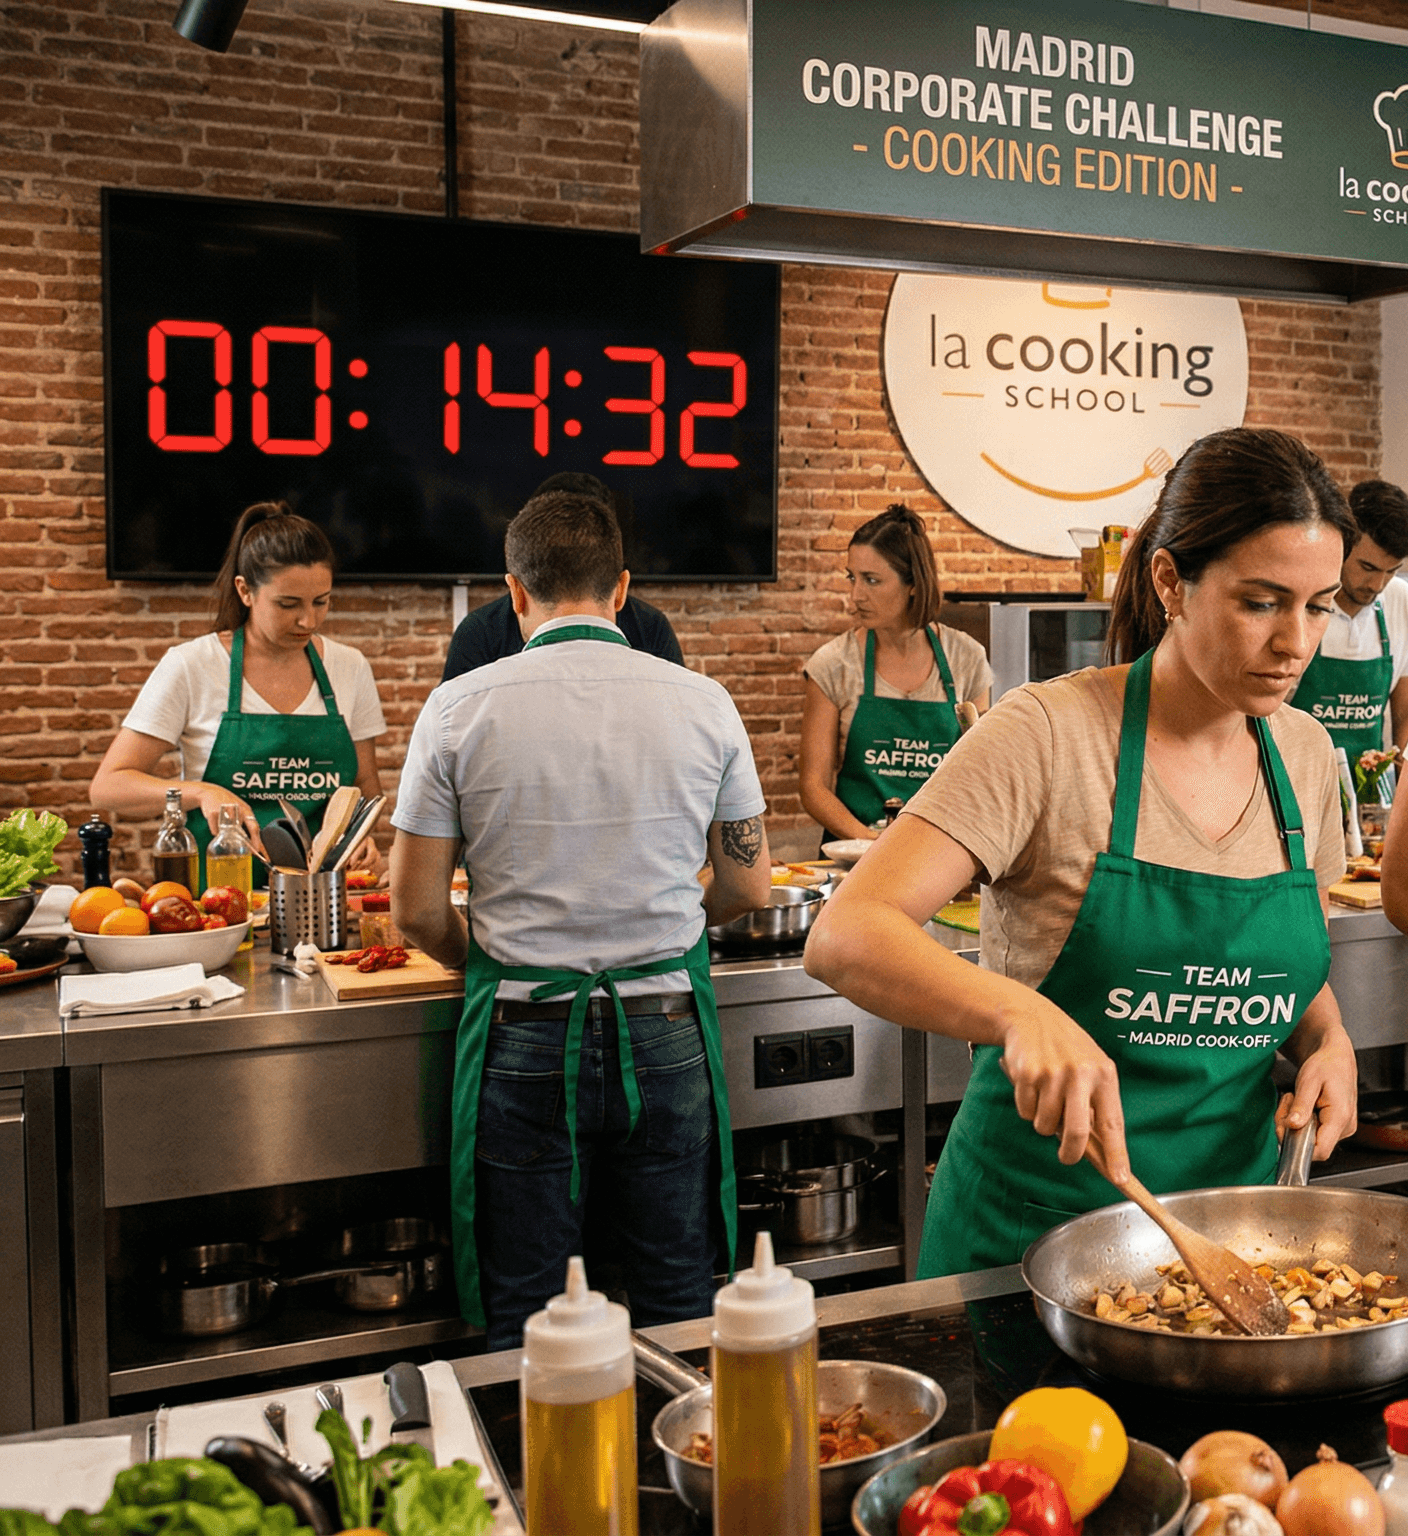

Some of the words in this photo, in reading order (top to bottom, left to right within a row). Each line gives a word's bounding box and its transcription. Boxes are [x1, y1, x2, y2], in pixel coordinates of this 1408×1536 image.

[975, 25, 1135, 87] MADRID
[802, 58, 1053, 131] CORPORATE
[1065, 92, 1283, 160] CHALLENGE
[883, 125, 1062, 187] COOKING
[1075, 146, 1217, 203] EDITION
[1339, 166, 1361, 199] la
[930, 313, 971, 369] la
[986, 322, 1214, 397] cooking
[1005, 385, 1145, 413] SCHOOL
[893, 737, 930, 751] TEAM
[268, 757, 310, 770] TEAM
[864, 749, 948, 769] SAFFRO
[231, 771, 341, 789] SAFFRON
[1183, 965, 1252, 987] TEAM
[1104, 987, 1296, 1026] SAFFRON
[1129, 1030, 1193, 1048] MADRID
[1195, 1033, 1272, 1049] COOK-OFF
